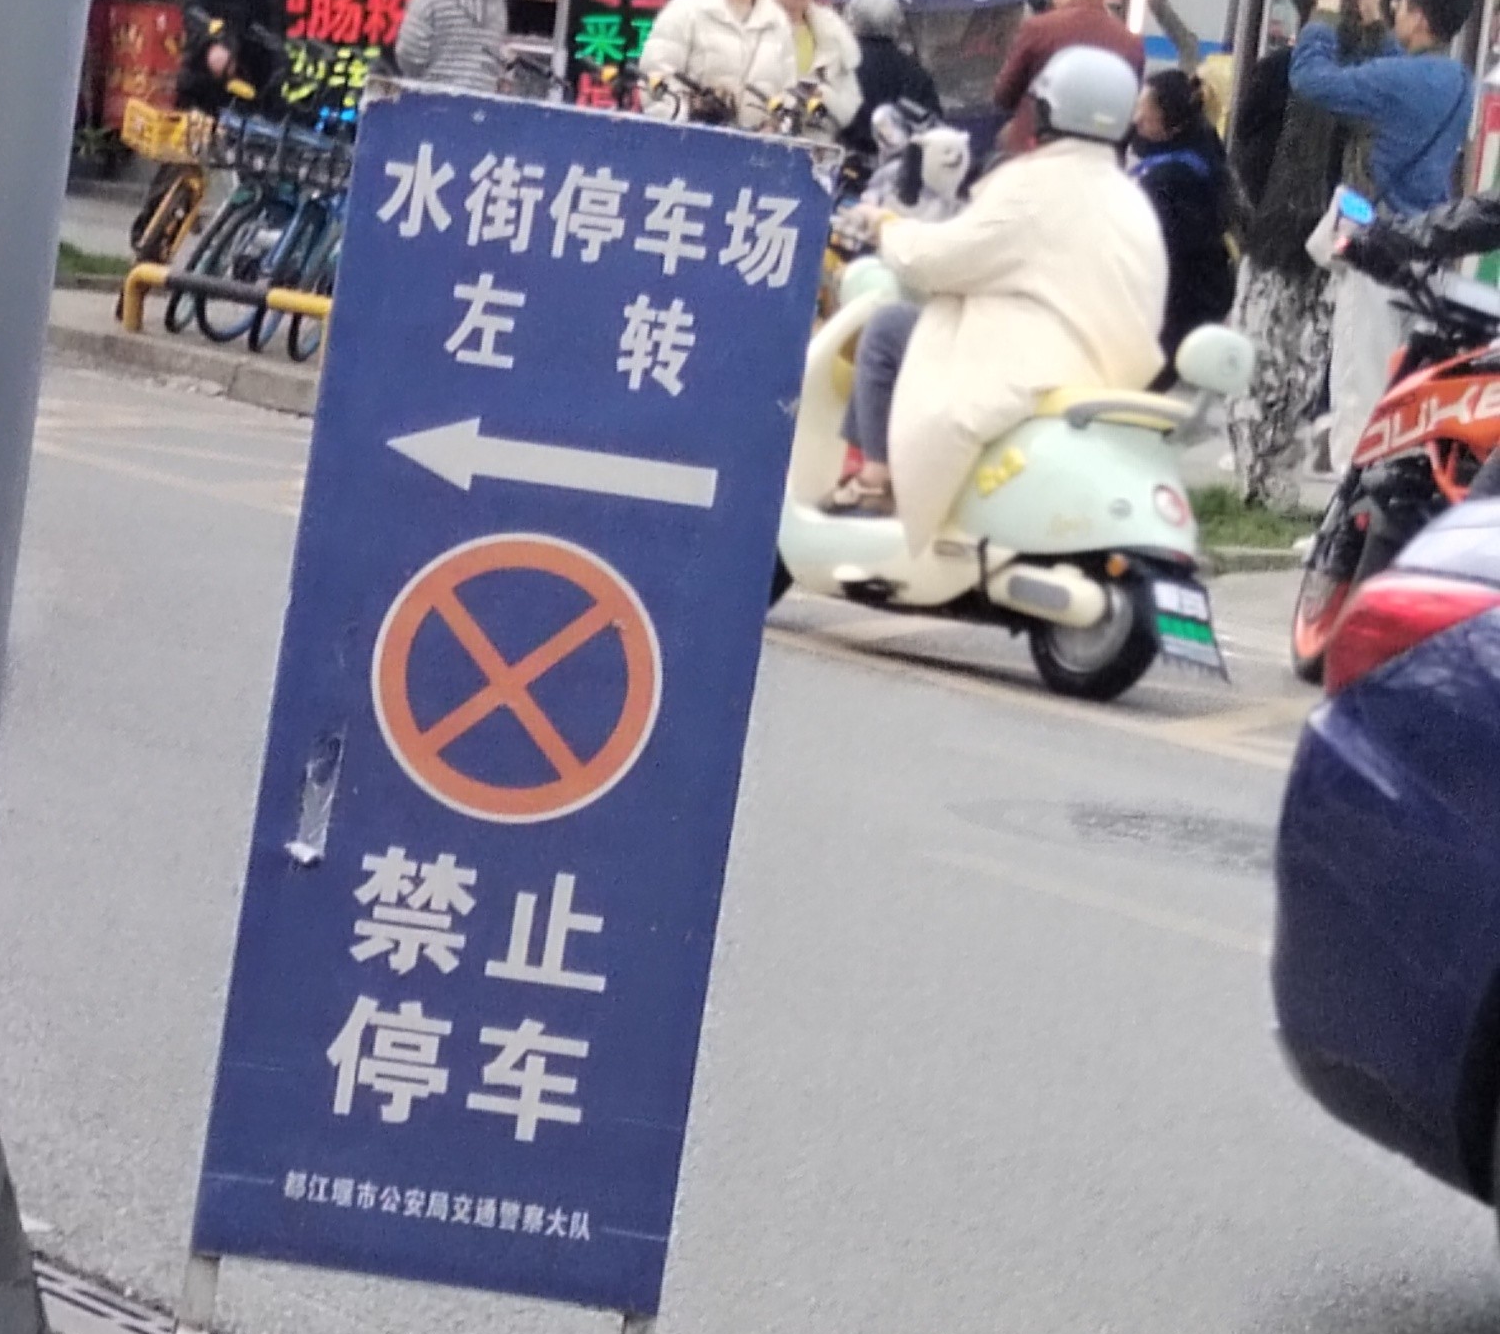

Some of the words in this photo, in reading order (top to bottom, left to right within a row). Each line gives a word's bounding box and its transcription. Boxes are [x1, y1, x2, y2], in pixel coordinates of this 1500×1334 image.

[377, 142, 802, 288] 水街停车场
[349, 845, 605, 992] 禁止
[326, 995, 589, 1142] 停车
[284, 1170, 590, 1241] 都江堰市公安局交通警察大队
